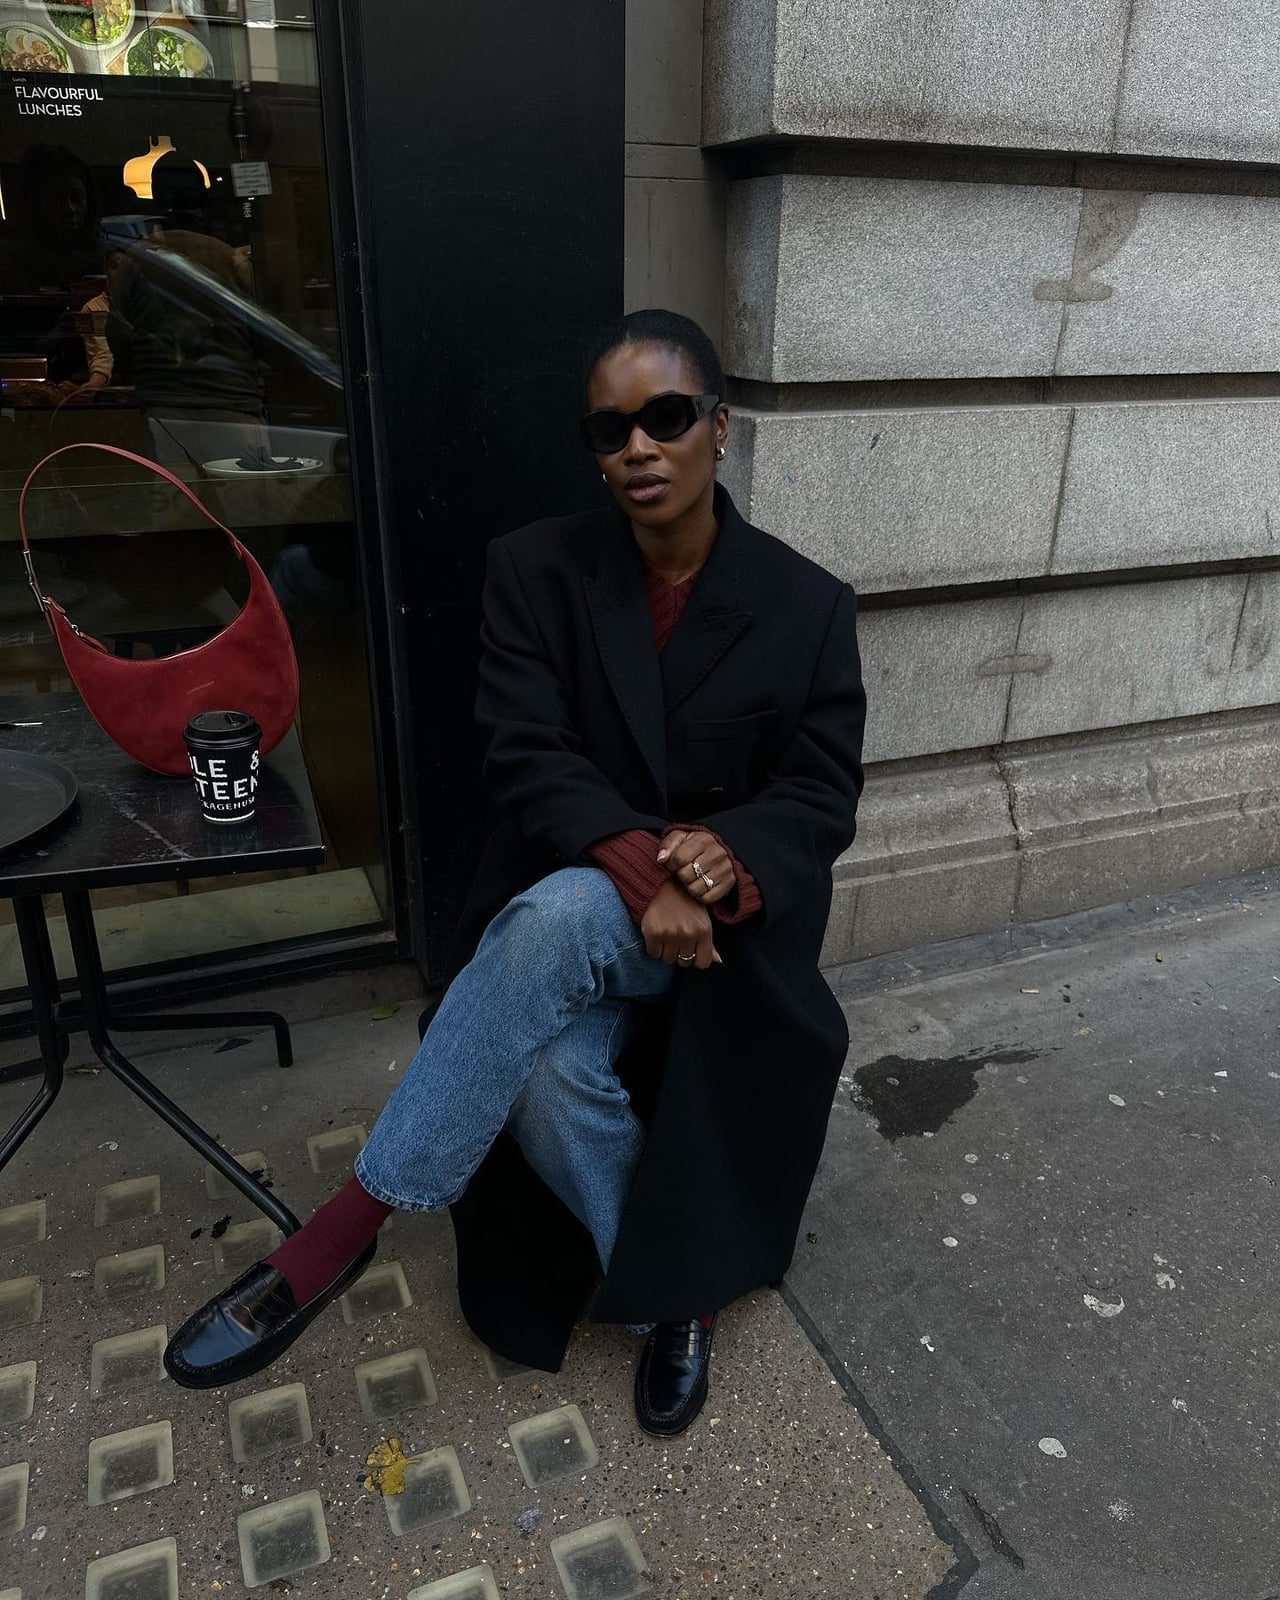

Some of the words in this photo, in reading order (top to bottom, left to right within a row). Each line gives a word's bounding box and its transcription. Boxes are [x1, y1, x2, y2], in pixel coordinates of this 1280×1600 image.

[15, 86, 104, 101] FLAVOURFUL
[18, 103, 83, 116] LUNCHES
[187, 751, 228, 778] LE
